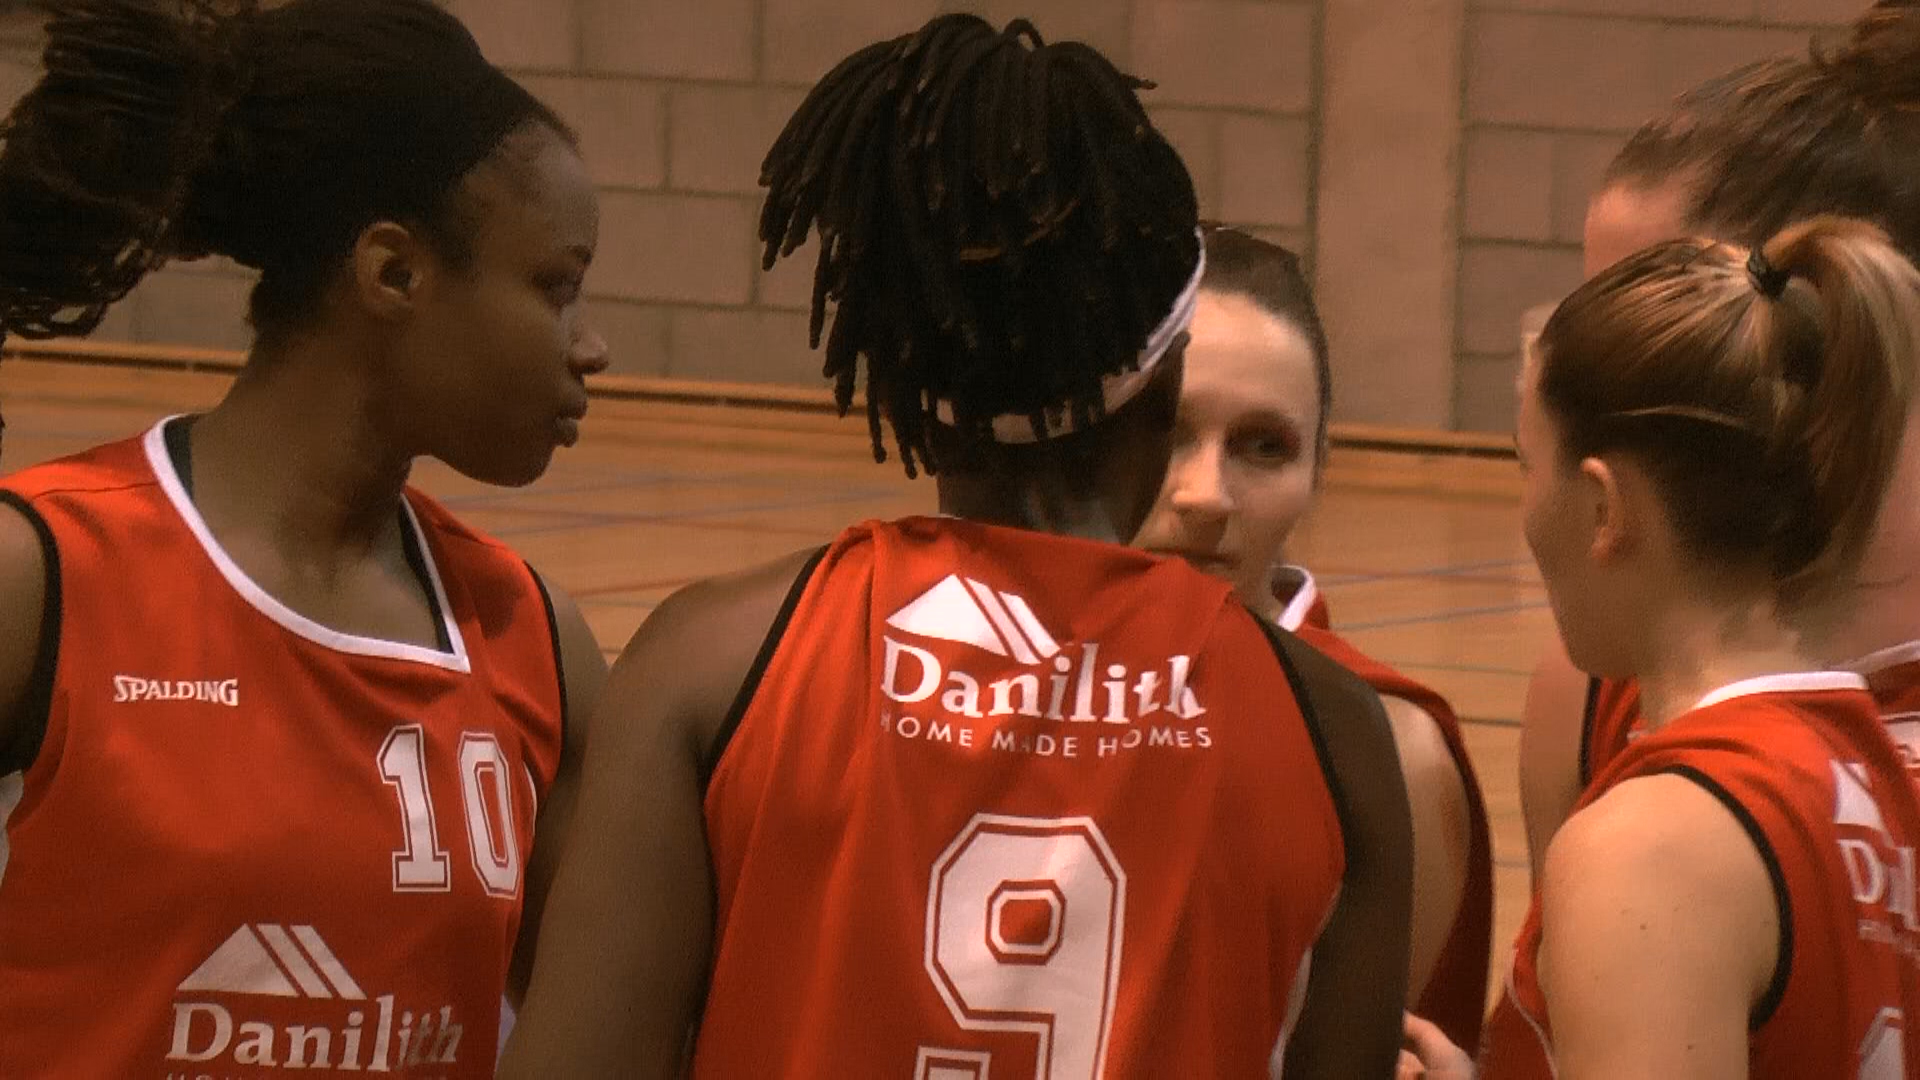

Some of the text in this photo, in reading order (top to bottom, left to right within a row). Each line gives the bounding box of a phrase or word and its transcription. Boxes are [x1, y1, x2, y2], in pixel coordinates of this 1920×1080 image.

[113, 674, 239, 707] SPALDING
[881, 634, 1207, 724] Danilith
[1097, 726, 1213, 758] HOMES
[376, 722, 520, 901] 10
[913, 812, 1128, 1080] 9
